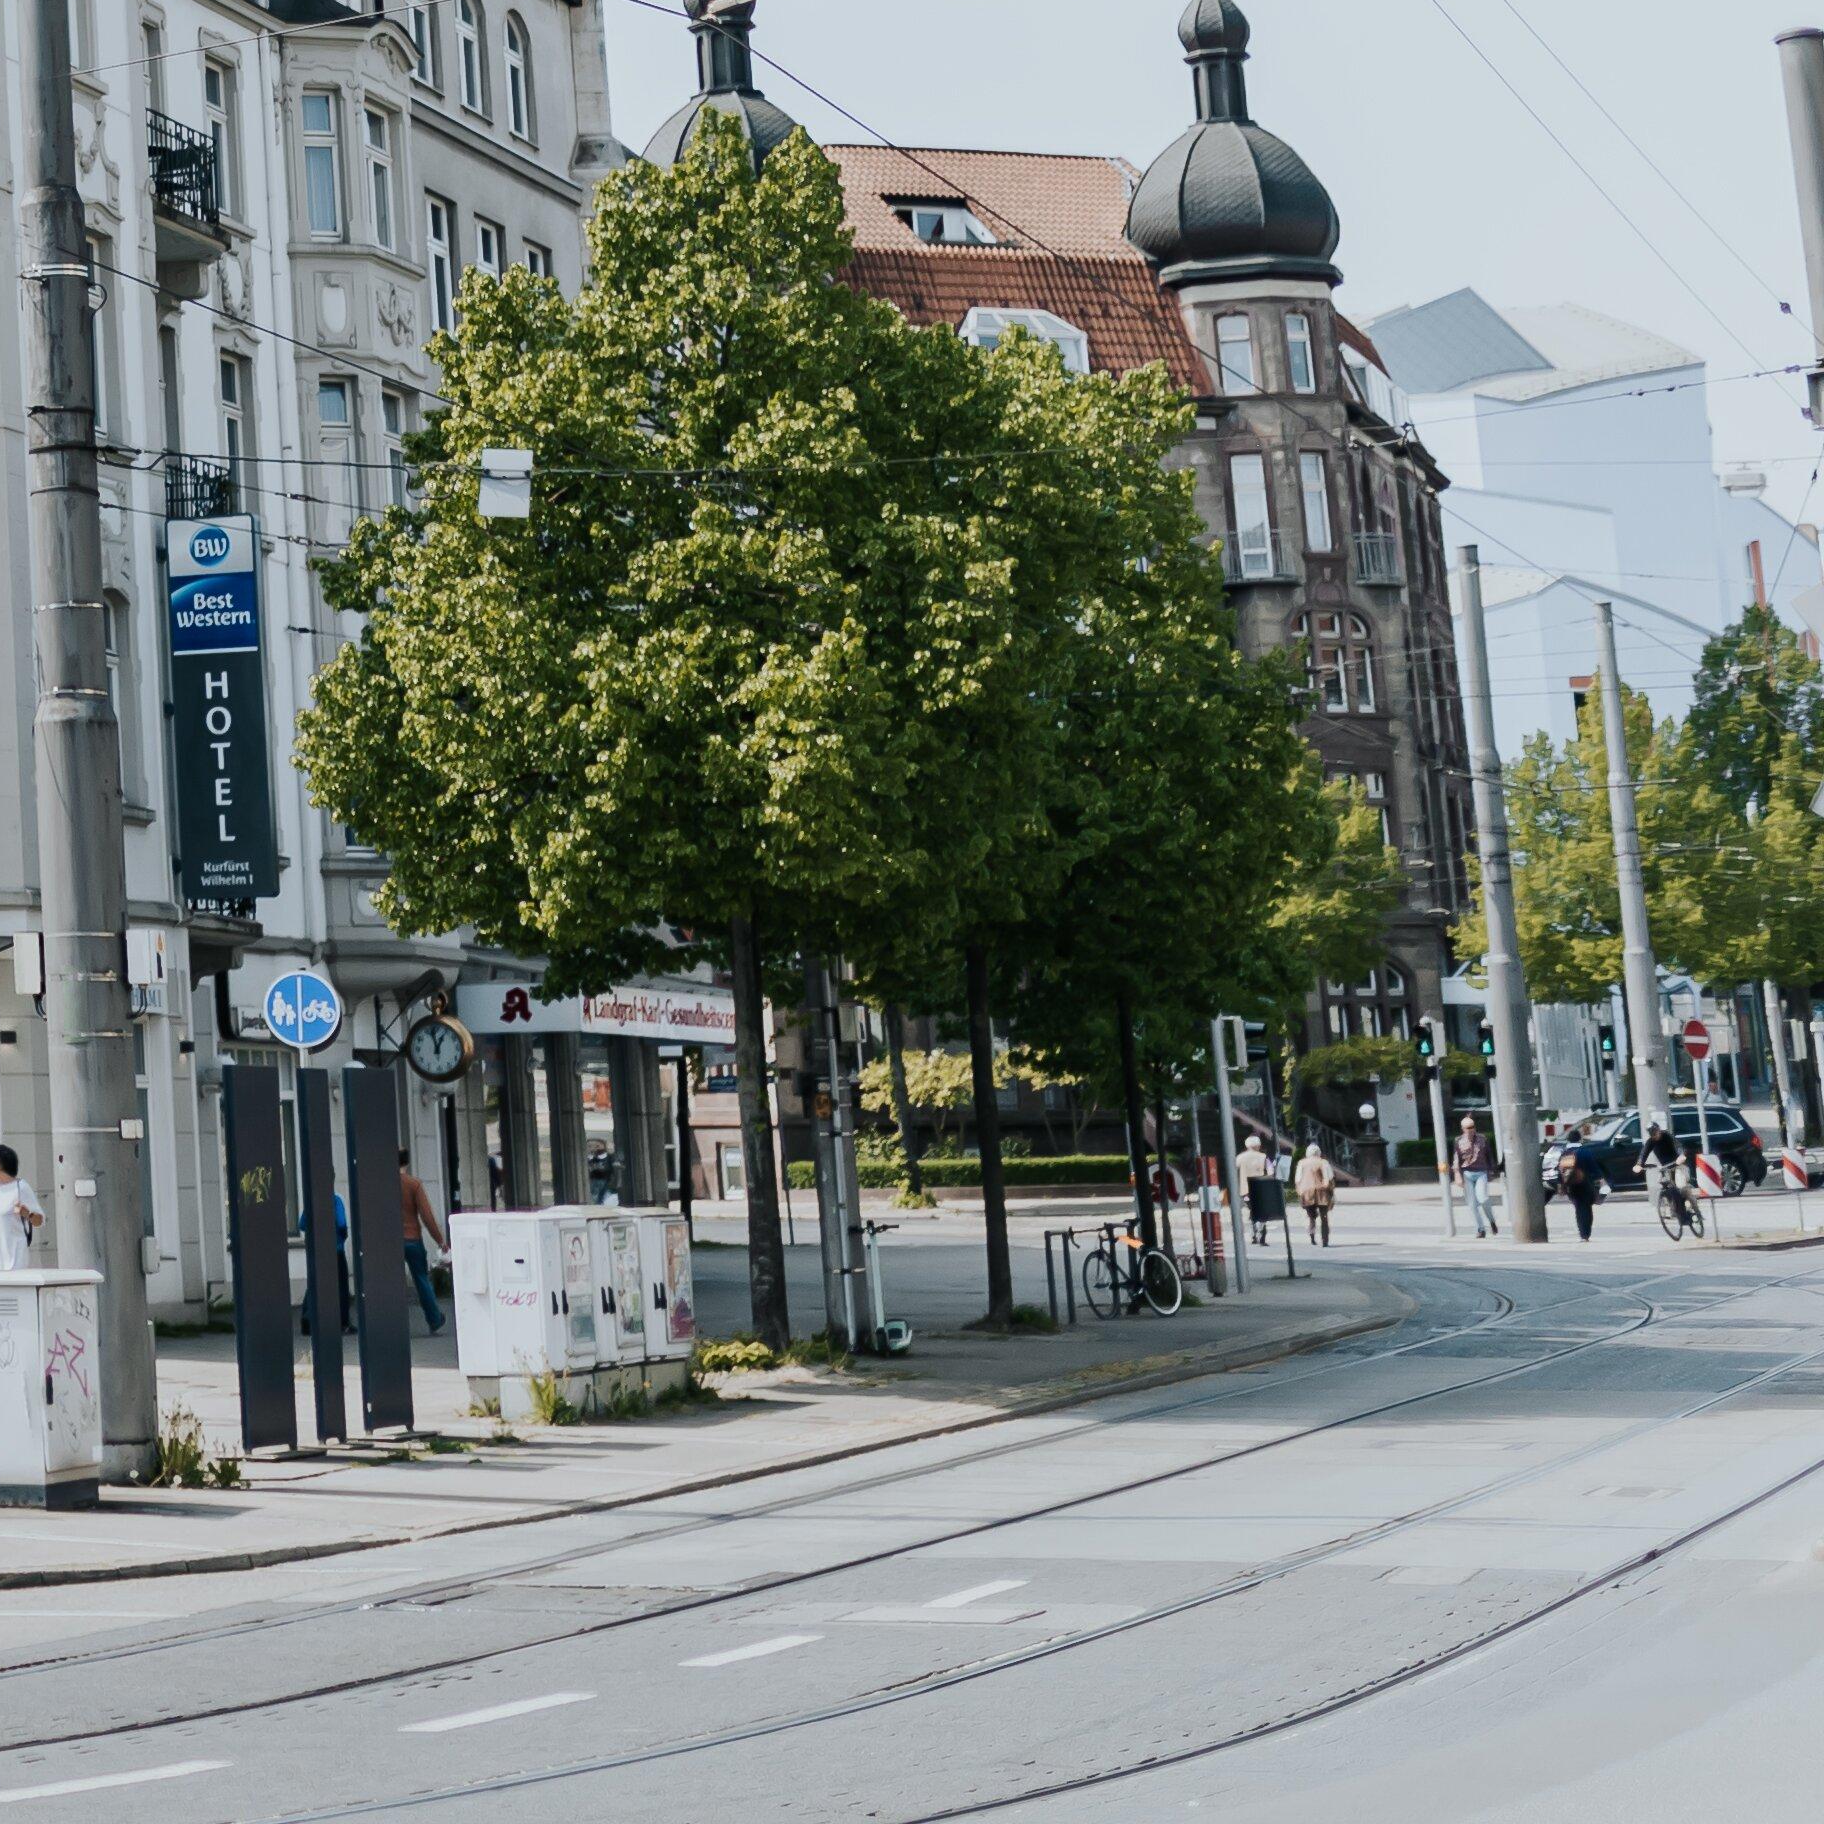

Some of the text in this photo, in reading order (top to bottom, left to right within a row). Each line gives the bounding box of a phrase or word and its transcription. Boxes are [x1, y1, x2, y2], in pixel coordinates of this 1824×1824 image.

[194, 538, 228, 558] BW
[193, 592, 234, 610] Best
[176, 610, 251, 628] Western
[205, 671, 236, 842] HOTEL
[203, 860, 250, 872] Kurfürst
[201, 874, 246, 886] Wilhelm
